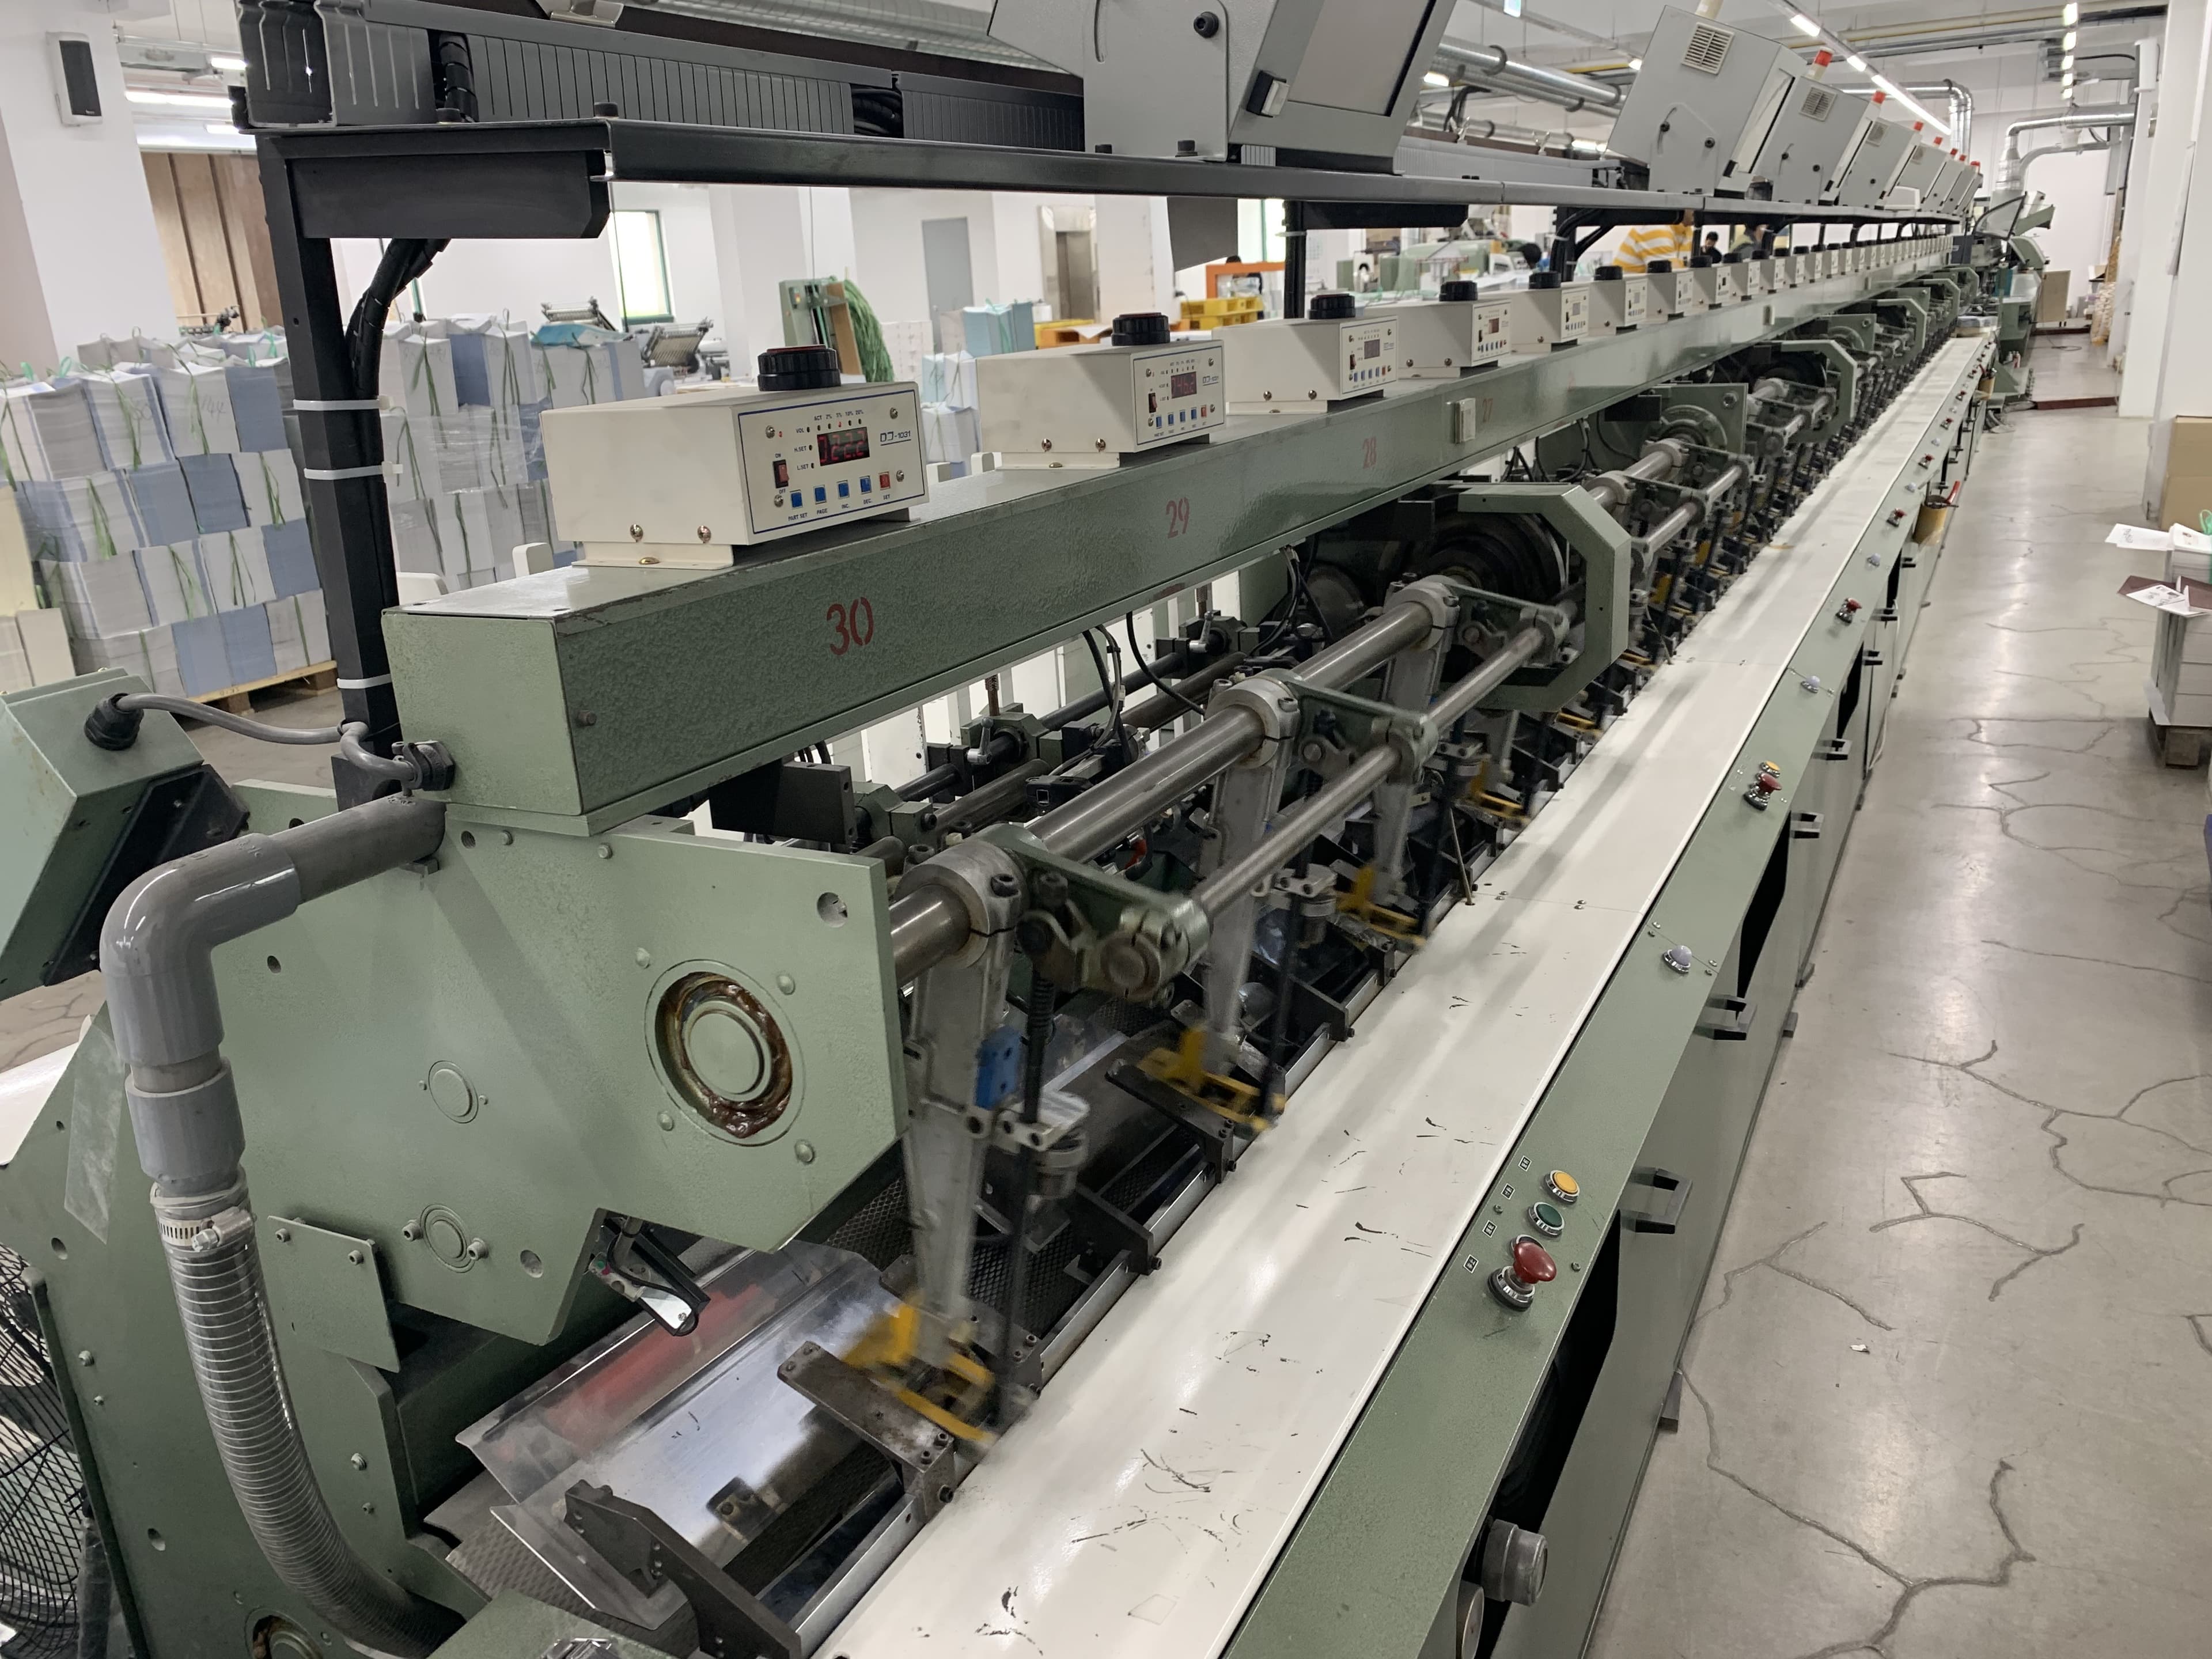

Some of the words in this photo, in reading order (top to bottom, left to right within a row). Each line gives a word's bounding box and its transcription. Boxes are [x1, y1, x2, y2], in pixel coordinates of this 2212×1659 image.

[1362, 437, 1376, 469] 28
[1165, 497, 1190, 539] 29
[826, 596, 874, 656] 30
